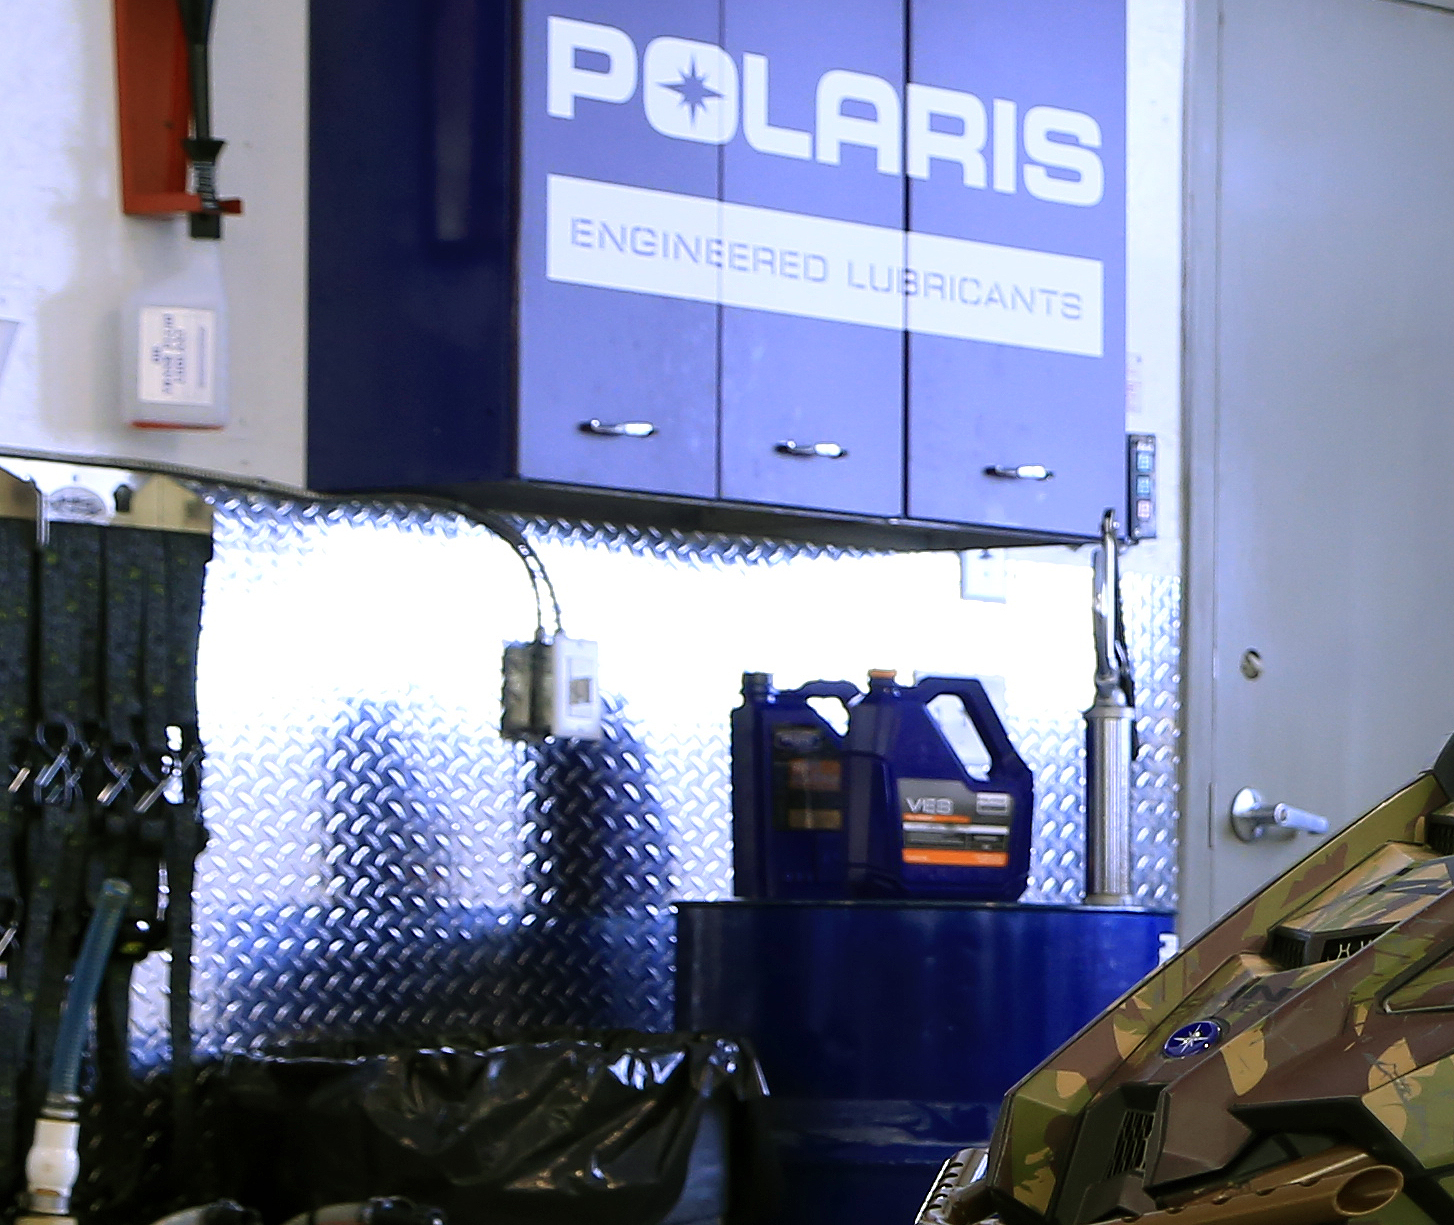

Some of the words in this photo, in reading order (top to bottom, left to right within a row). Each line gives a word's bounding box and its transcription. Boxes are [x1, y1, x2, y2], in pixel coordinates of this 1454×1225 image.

[547, 15, 1104, 209] POLARIS
[570, 216, 829, 284] ENGINEERED
[846, 260, 1085, 321] LUBRICANTS
